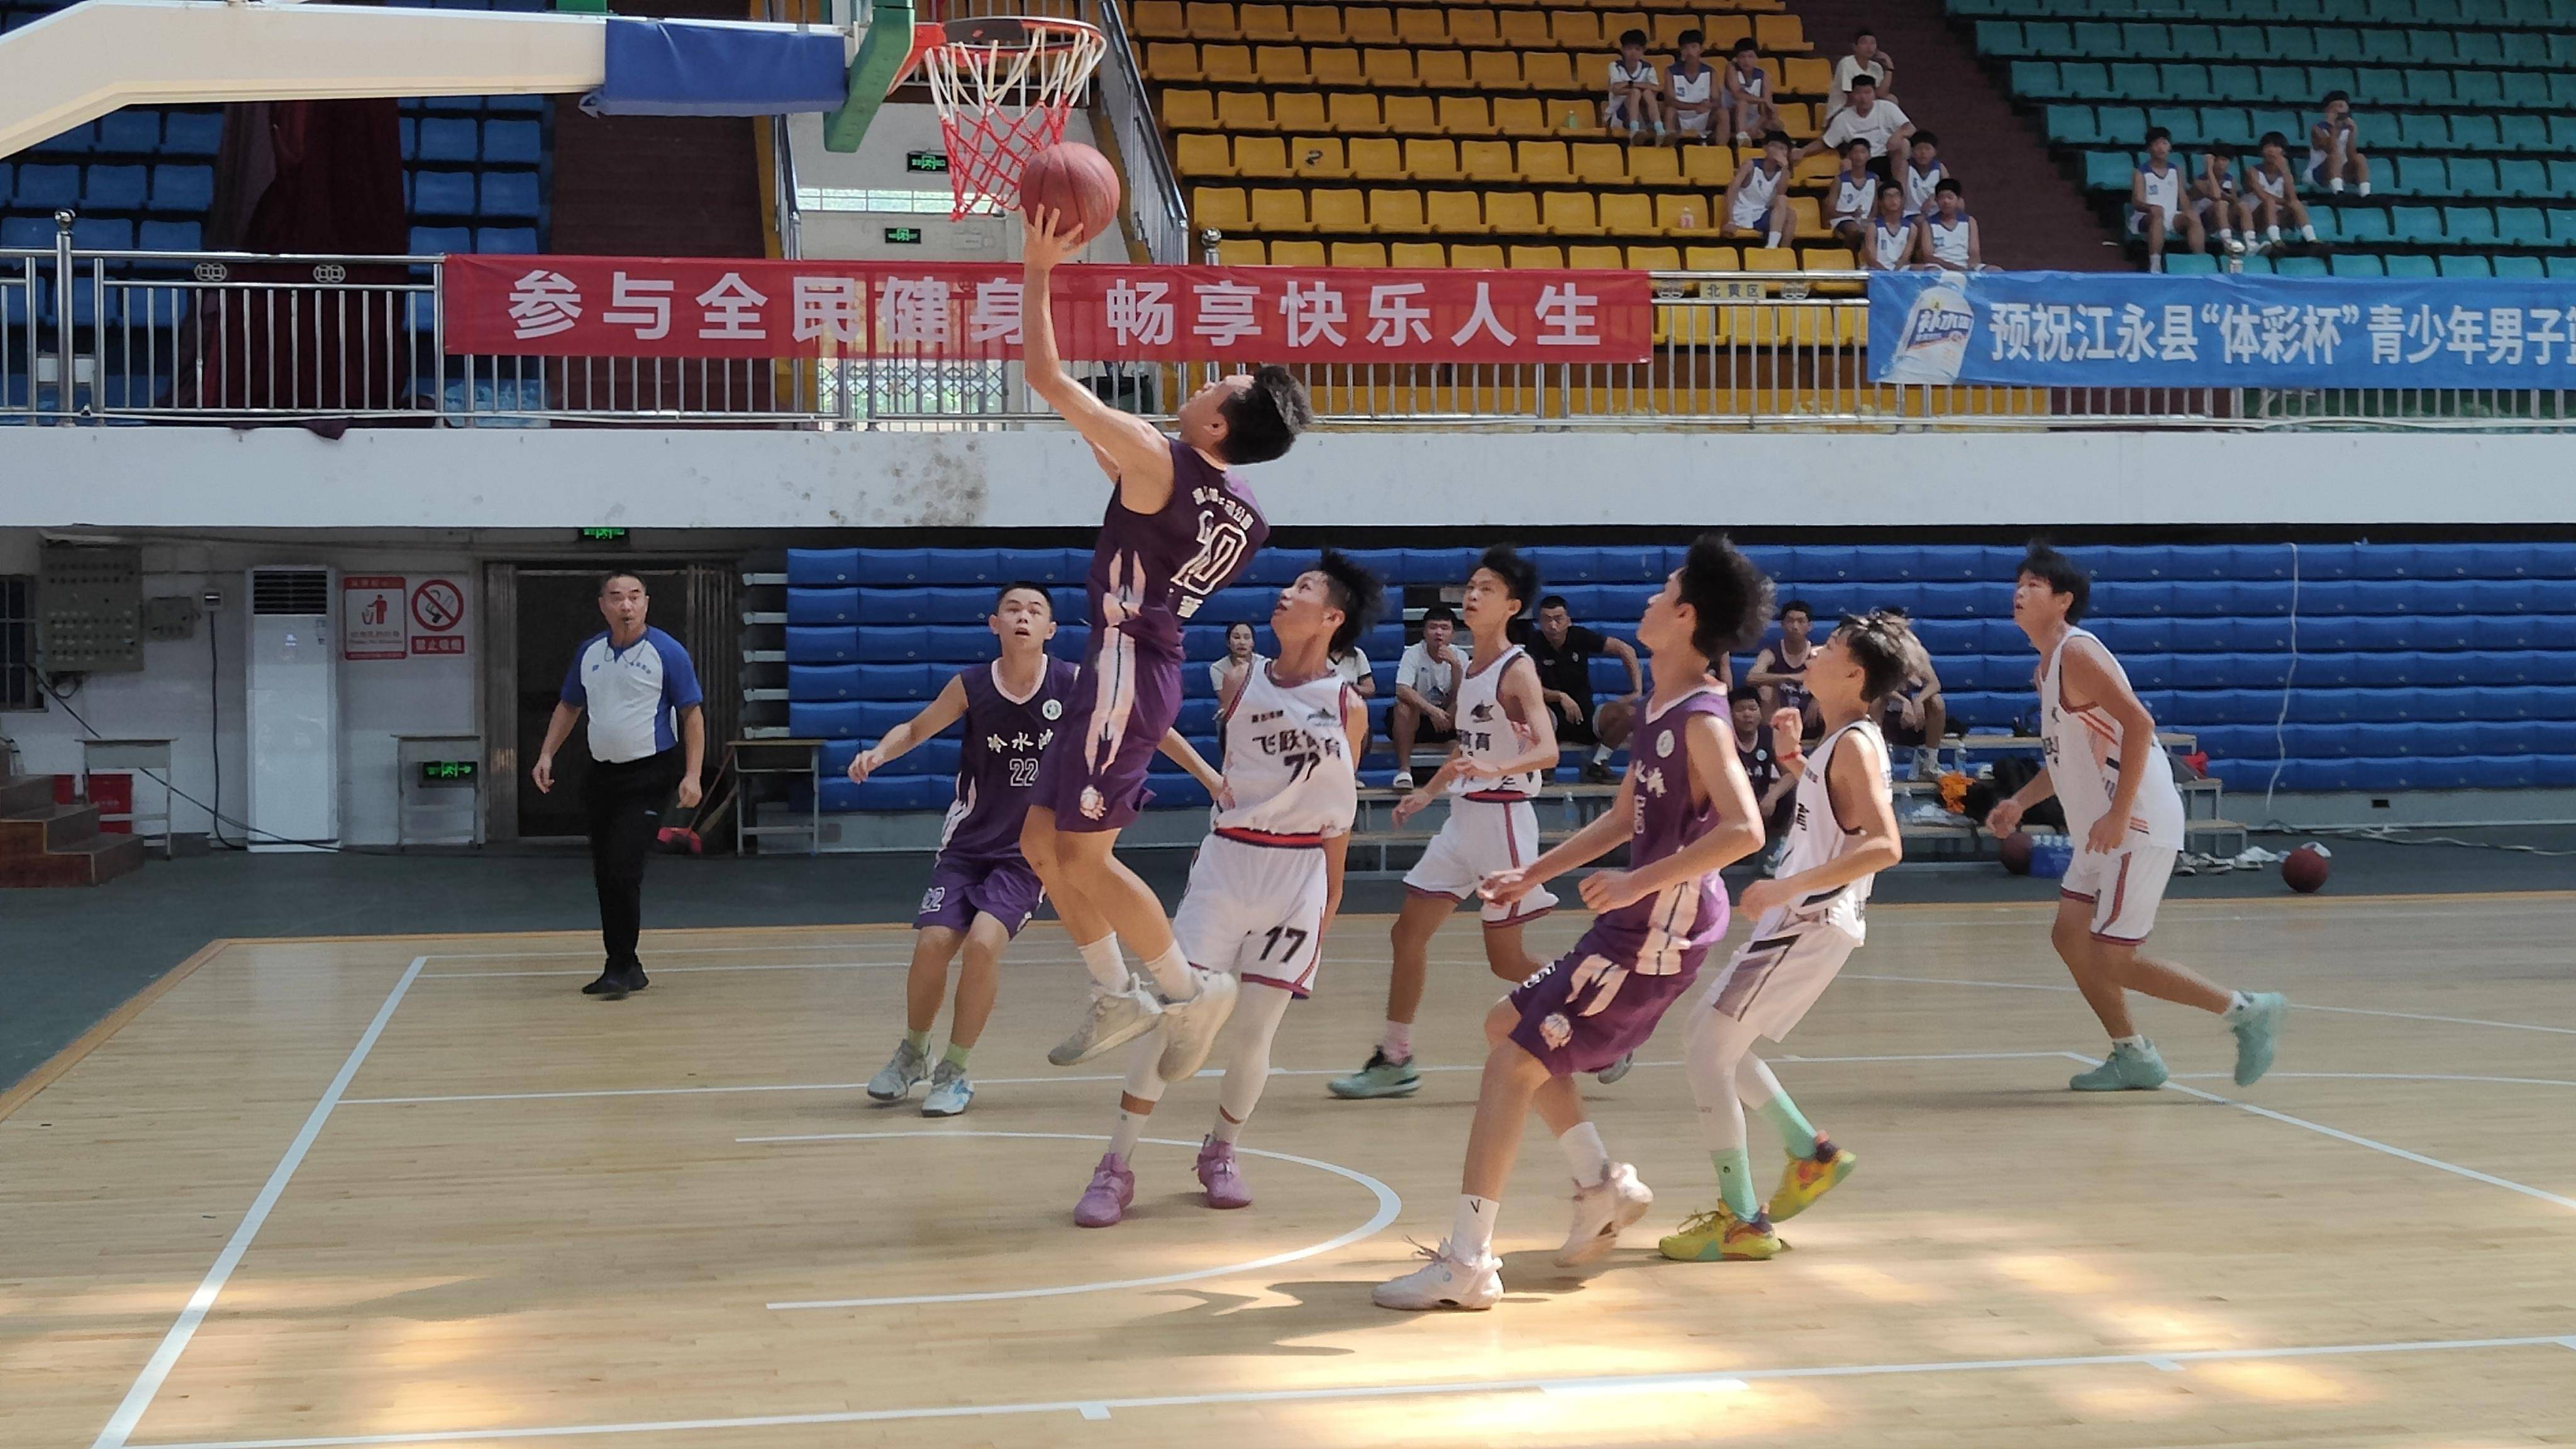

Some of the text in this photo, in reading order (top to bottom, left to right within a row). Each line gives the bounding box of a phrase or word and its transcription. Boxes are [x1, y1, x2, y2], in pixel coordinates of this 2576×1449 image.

[508, 270, 1601, 348] 参与全民健身 畅享快乐人生
[1989, 303, 2576, 365] 预祝江永县“体彩杯”青少年男子
[1009, 758, 1040, 787] 22
